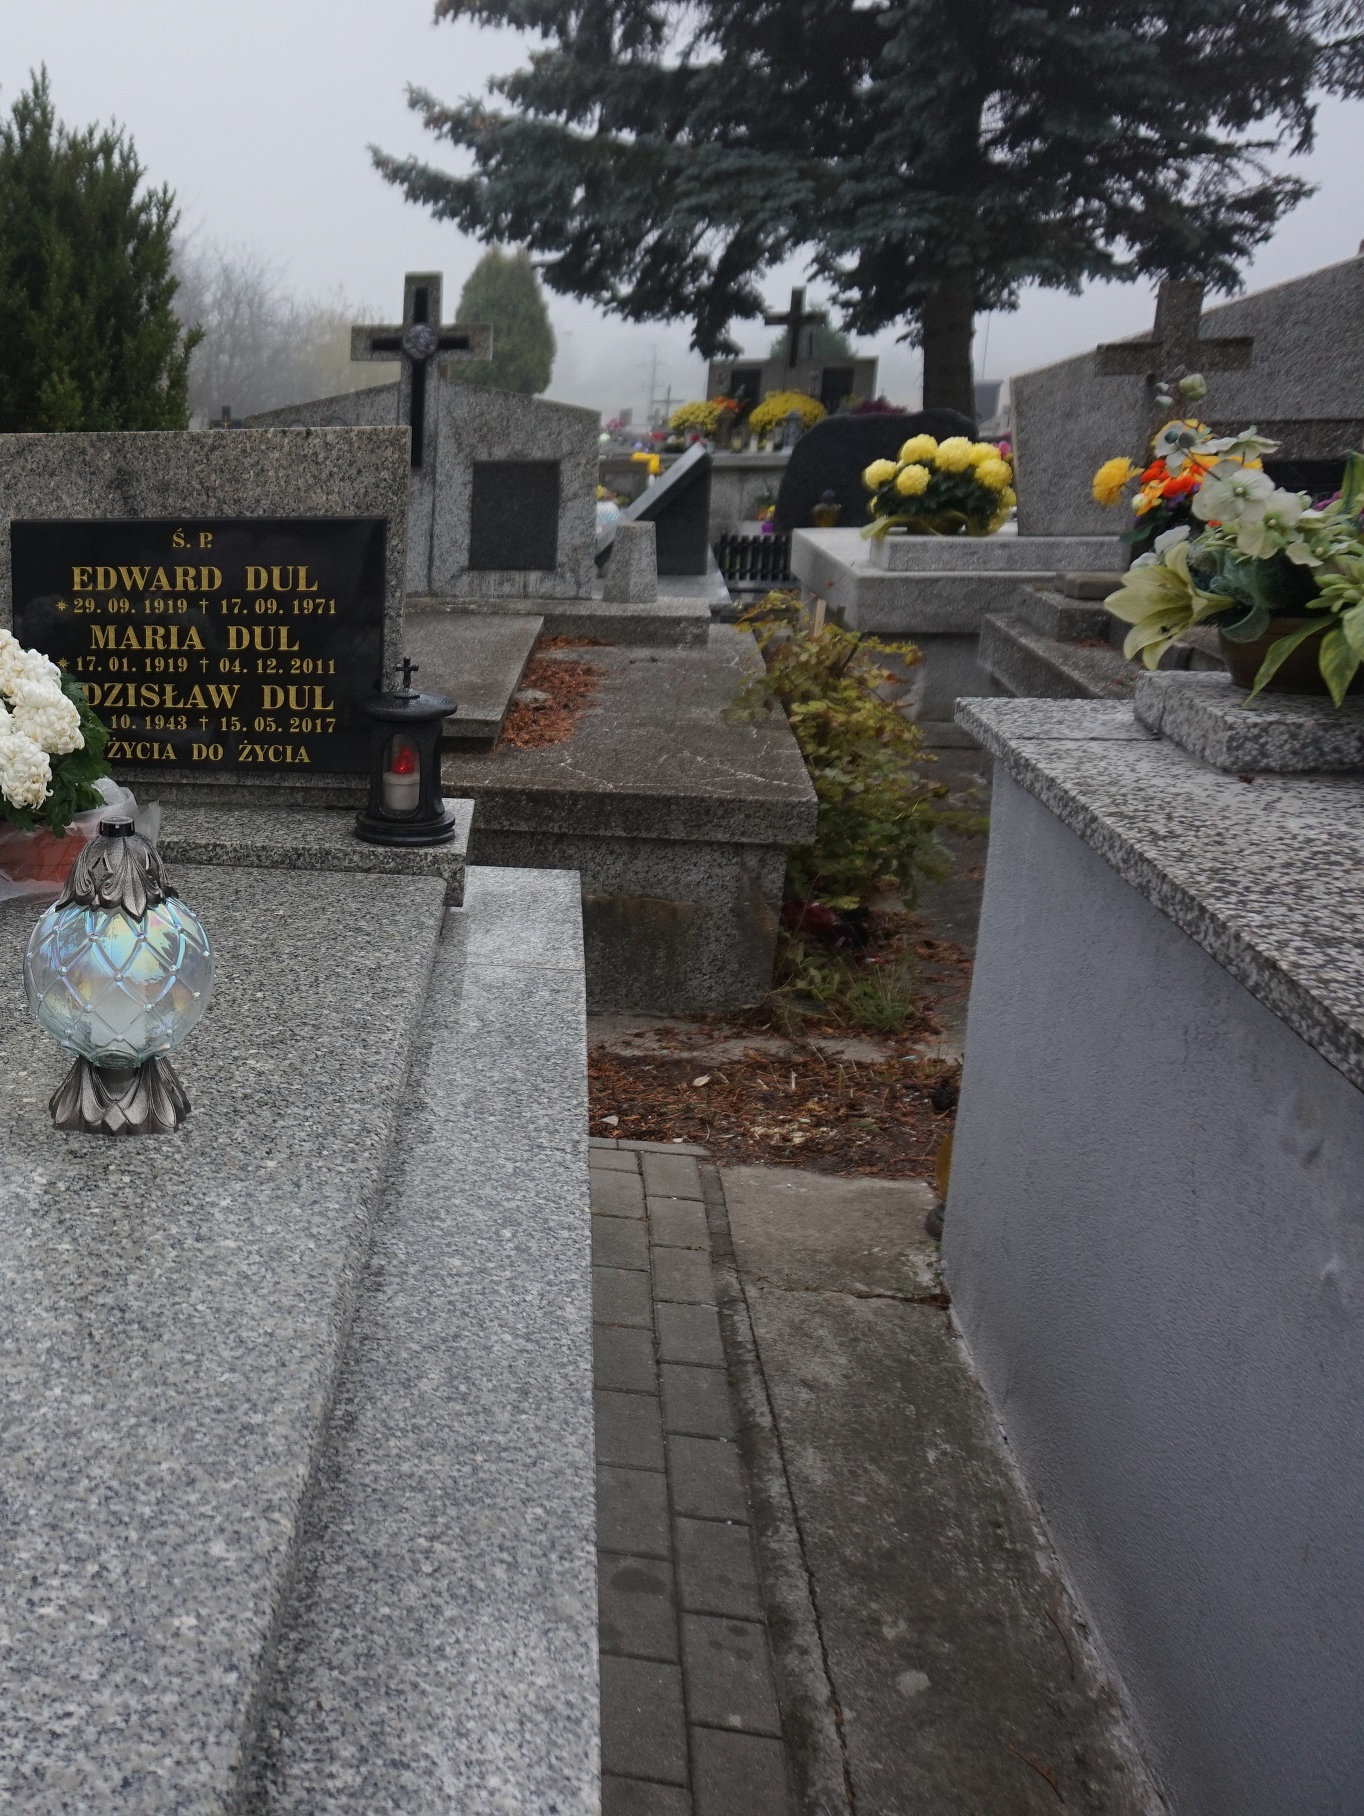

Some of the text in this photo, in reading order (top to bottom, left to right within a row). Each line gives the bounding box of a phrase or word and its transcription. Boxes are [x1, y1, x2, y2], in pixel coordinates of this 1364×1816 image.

[173, 528, 214, 548] Ś. P.
[72, 566, 319, 591] EDWARD DUL
[73, 598, 337, 615] 29. 09. 1919 17. 09. 1971
[91, 625, 300, 651] MARIA DUL
[77, 657, 337, 674] 17. 01. 1919 04. 12. 2011
[82, 683, 335, 710] DZISŁAW DUL
[111, 714, 136, 729] 10.
[145, 714, 188, 730] 1943
[221, 716, 247, 732] 15.
[254, 717, 283, 733] 05.
[290, 718, 337, 733] 2017
[107, 737, 311, 763] ŻYCIA DO ŻYCIA
